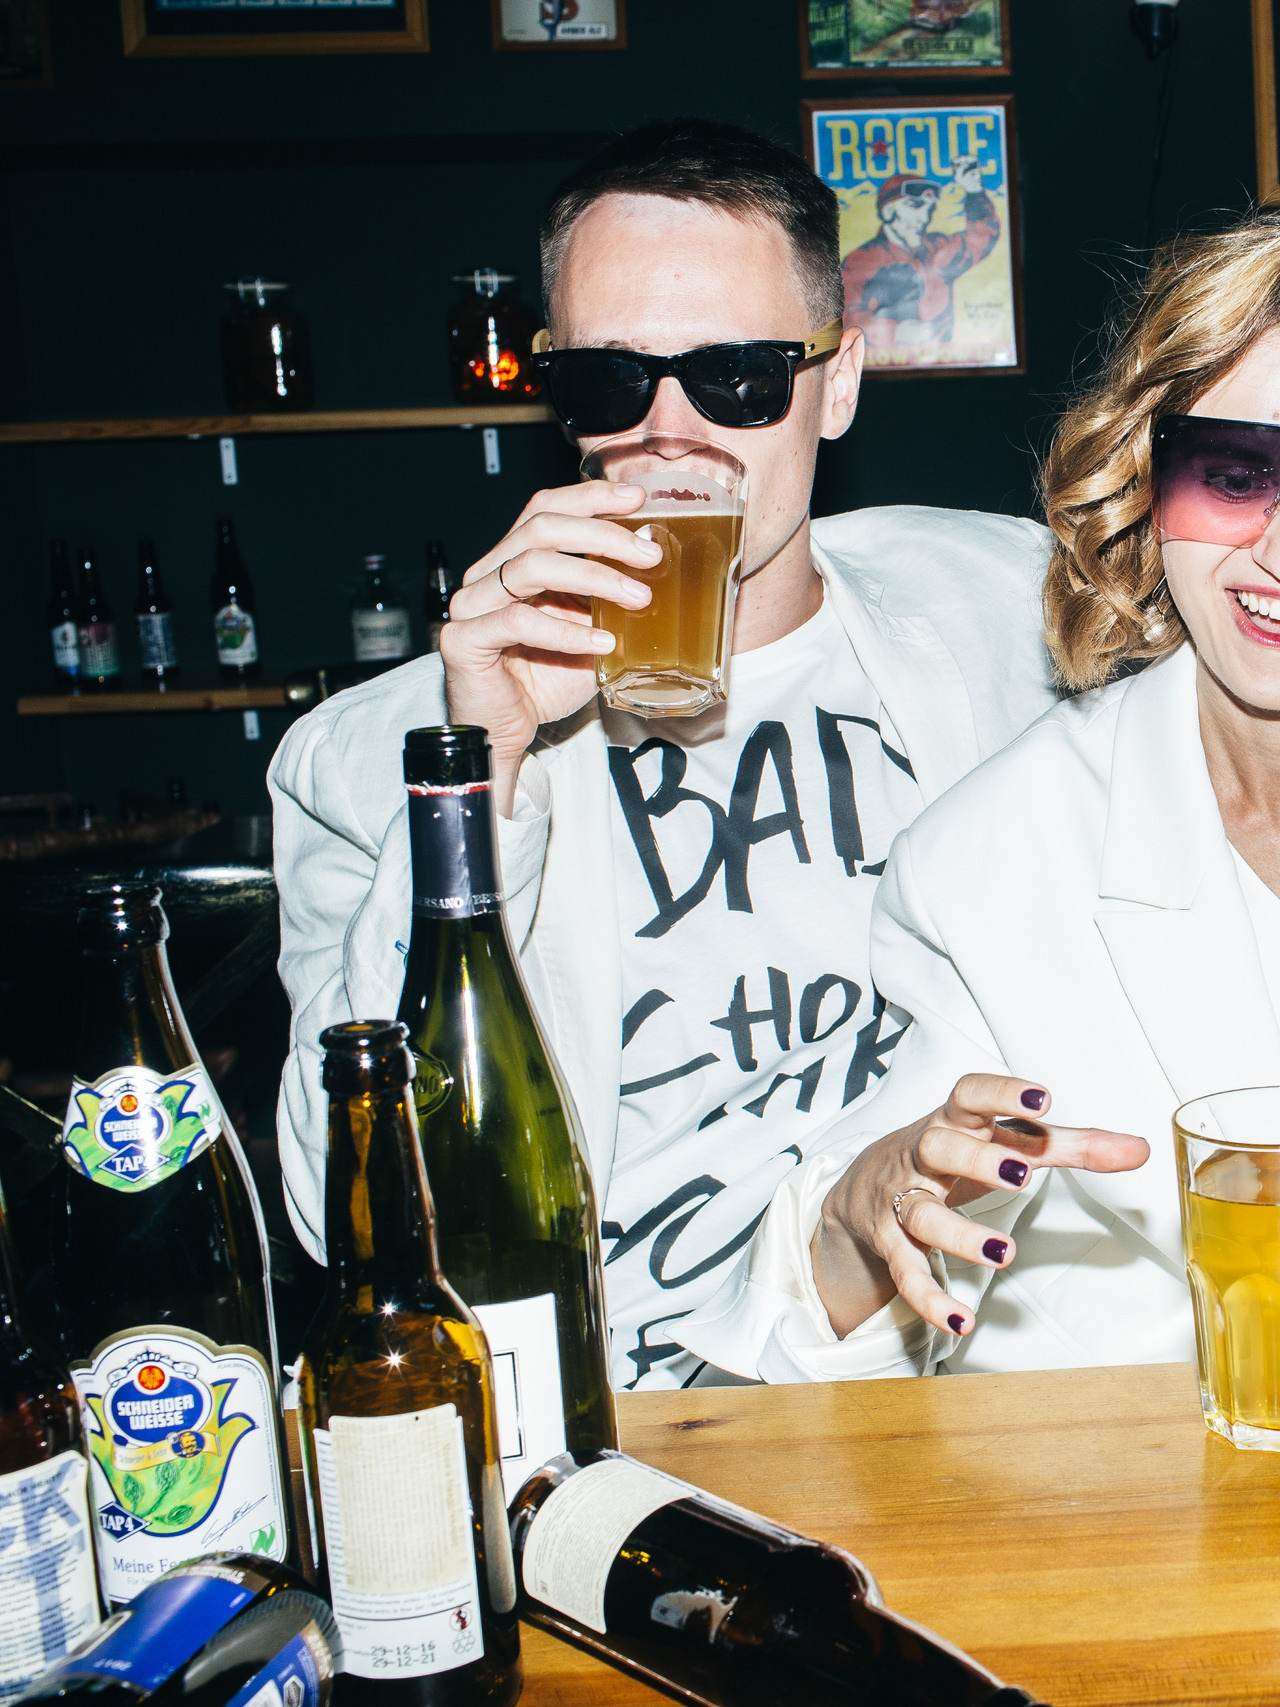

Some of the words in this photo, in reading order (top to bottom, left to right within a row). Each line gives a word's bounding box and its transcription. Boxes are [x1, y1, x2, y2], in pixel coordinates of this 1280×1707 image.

[825, 114, 998, 181] ROGUE
[608, 705, 919, 938] BAD
[620, 965, 888, 1095] CHO
[116, 1393, 195, 1417] SCHNEIDER
[129, 1410, 185, 1431] WEISSE
[100, 1512, 134, 1532] TAP4
[112, 1556, 155, 1574] Meine
